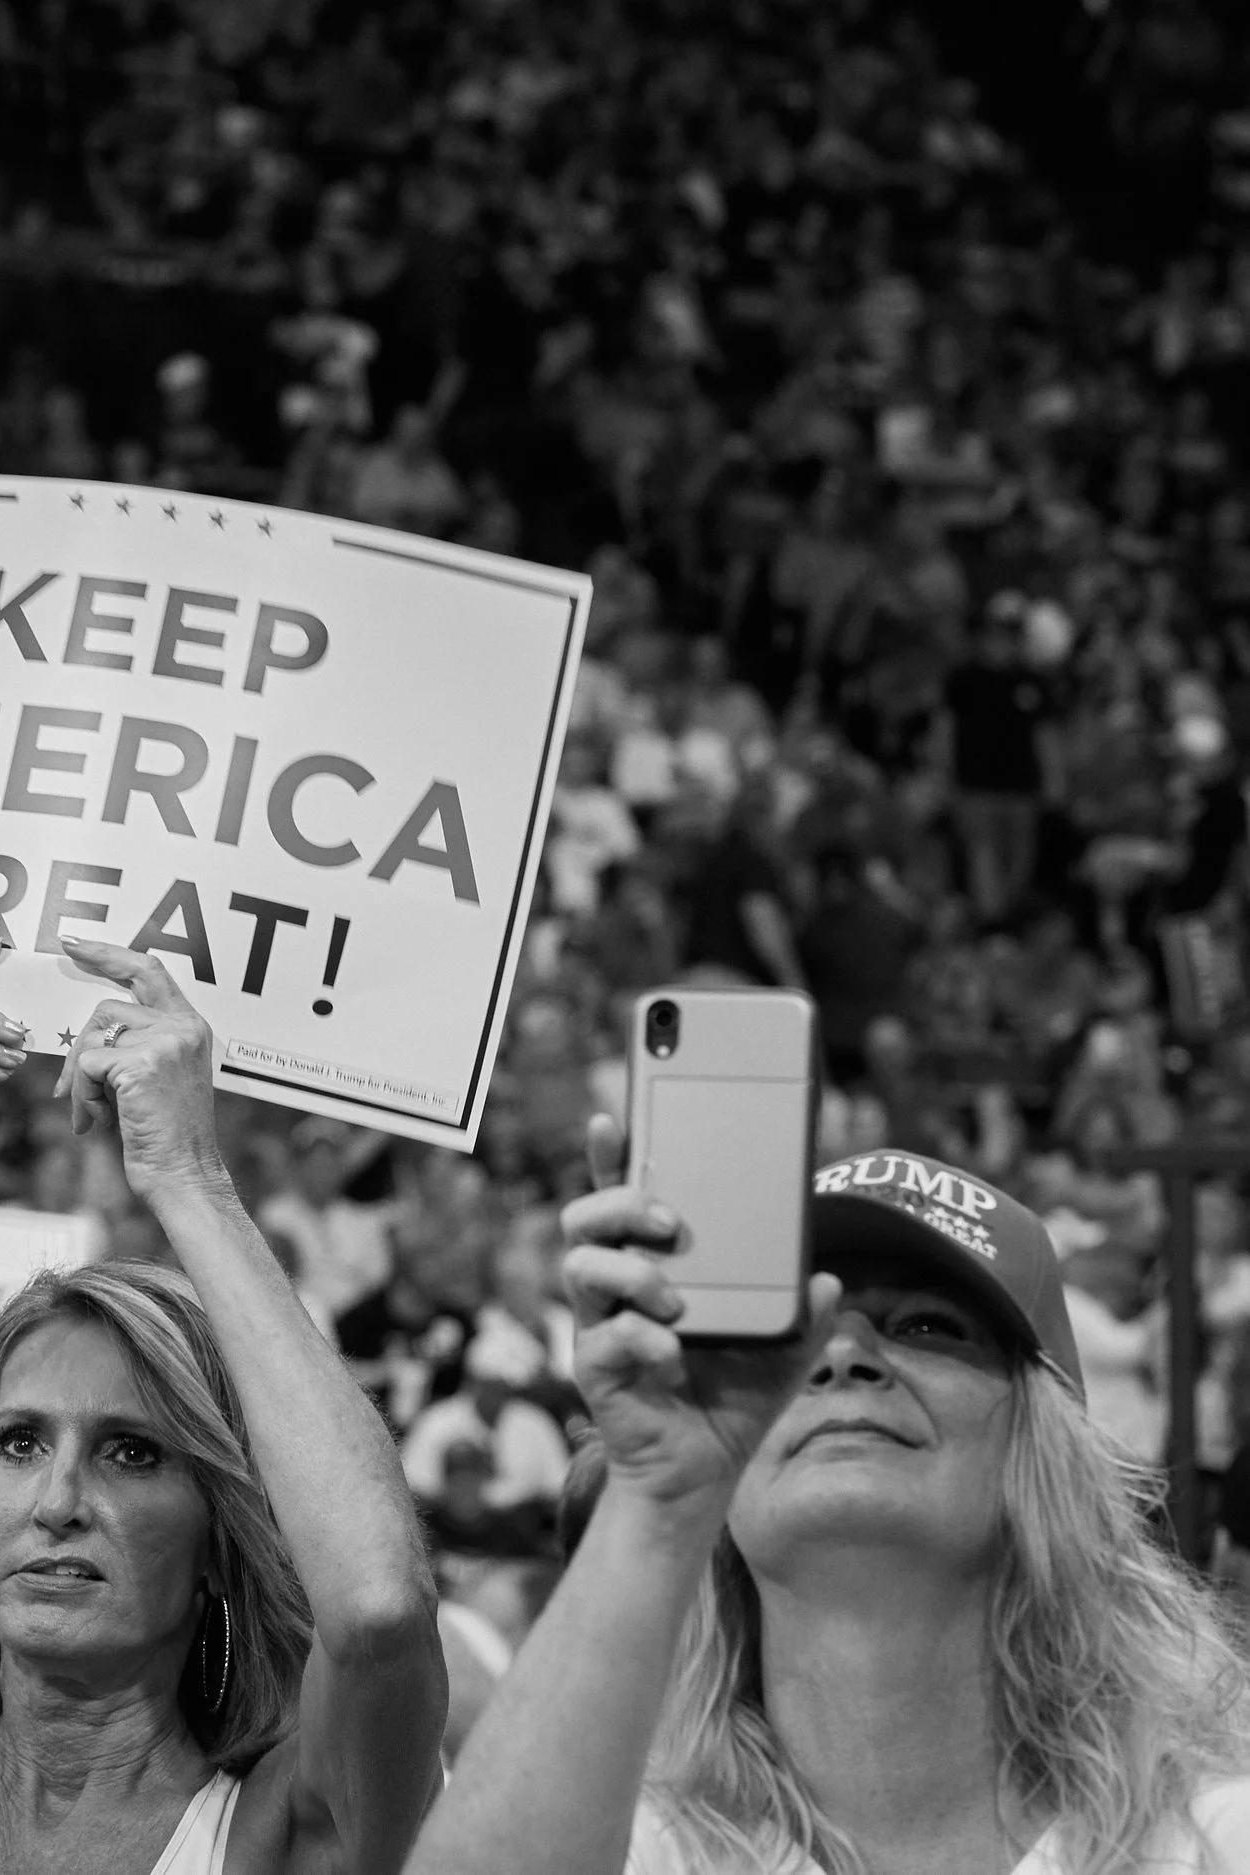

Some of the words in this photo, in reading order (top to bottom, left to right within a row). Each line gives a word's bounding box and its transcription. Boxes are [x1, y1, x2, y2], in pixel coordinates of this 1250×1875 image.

[237, 1044, 259, 1060] Paid
[260, 1050, 273, 1062] for
[275, 1053, 288, 1068] by
[289, 1058, 325, 1075] Donald
[335, 1067, 366, 1089] Trump
[814, 1155, 998, 1220] RUMP
